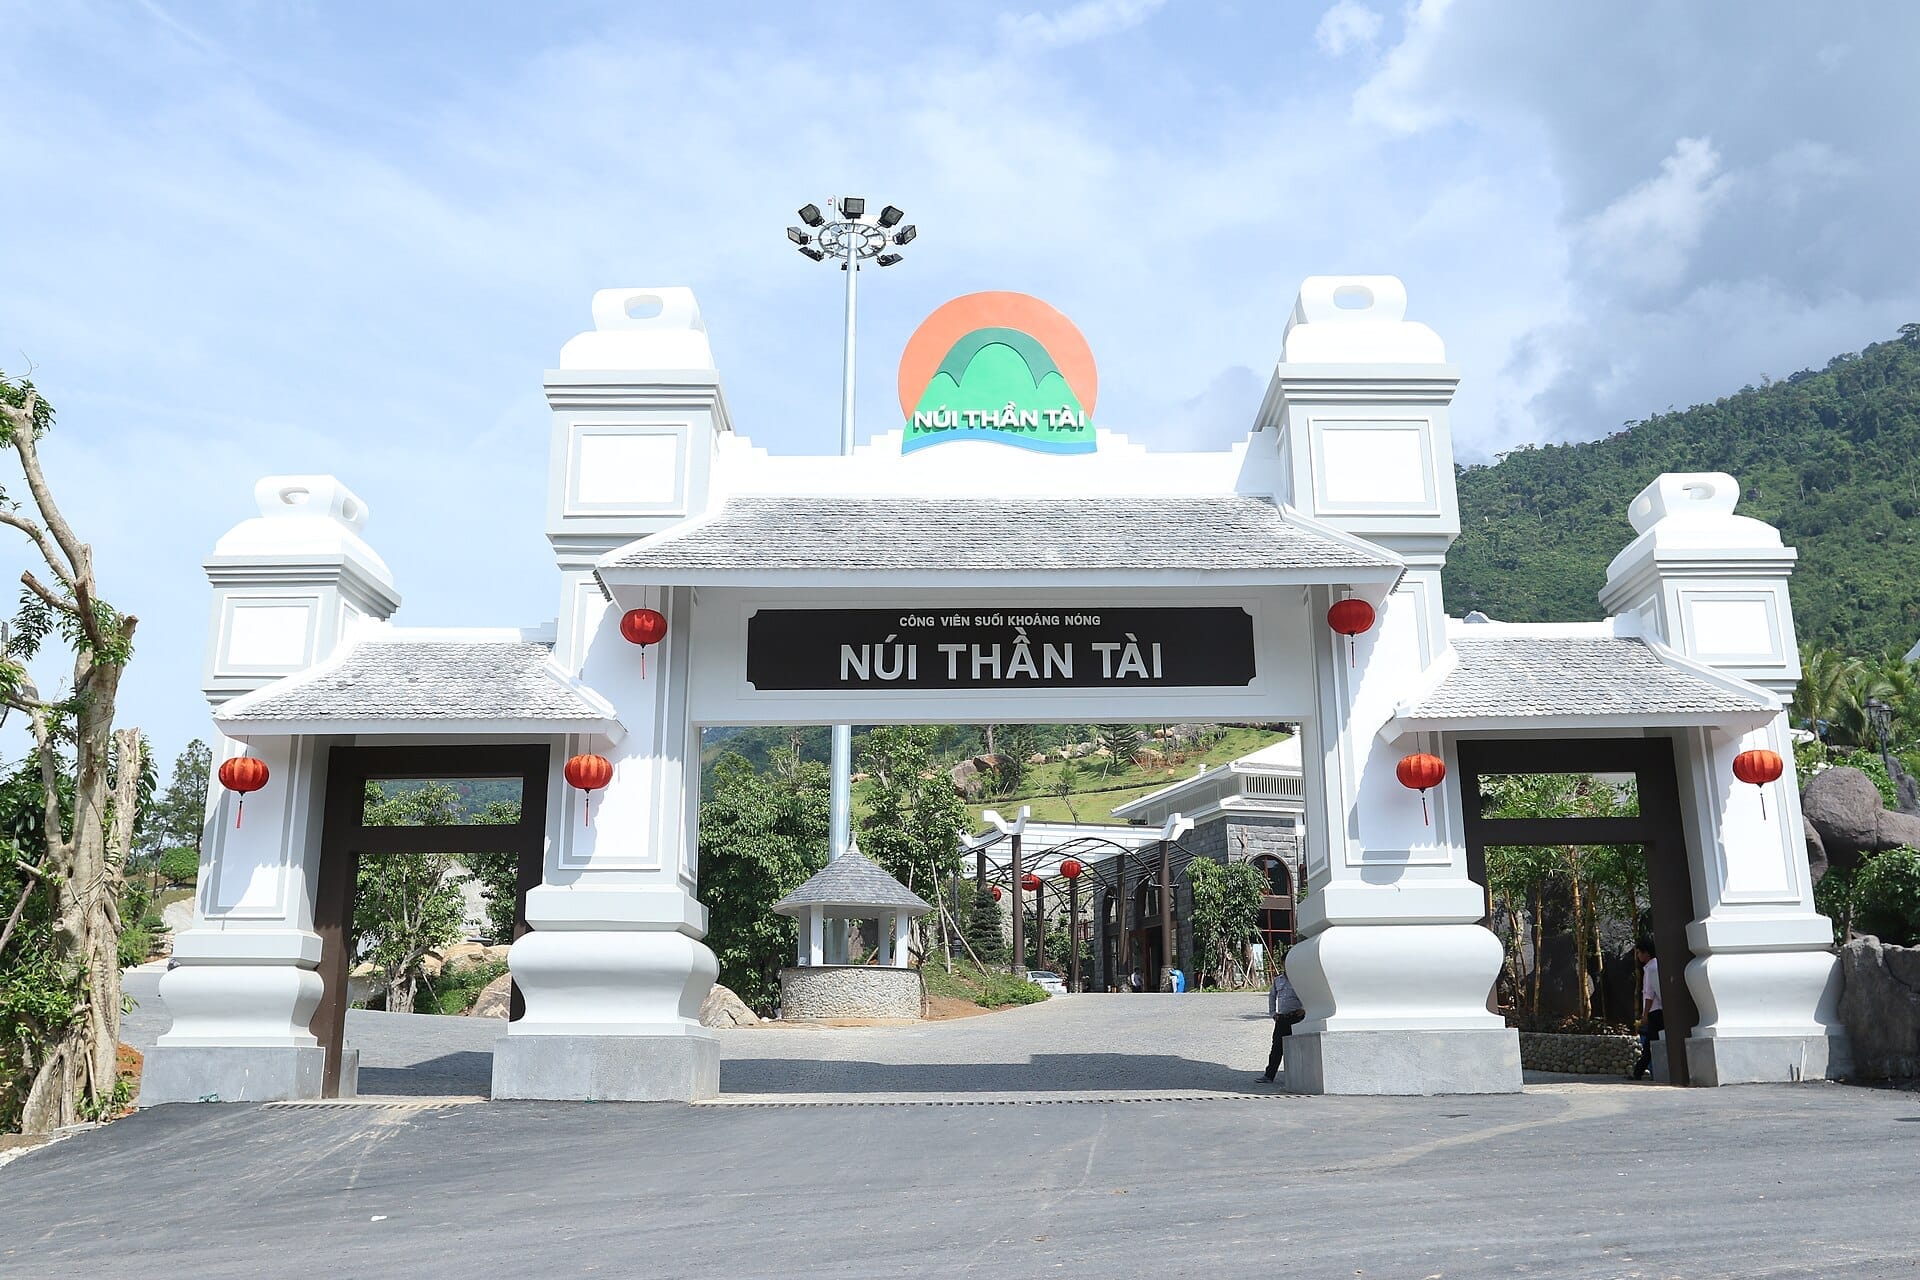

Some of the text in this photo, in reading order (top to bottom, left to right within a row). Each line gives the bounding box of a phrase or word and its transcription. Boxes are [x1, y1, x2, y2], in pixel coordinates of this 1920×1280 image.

[914, 401, 1085, 429] NÚI THẦN TÀI
[899, 610, 1101, 627] CÔNG VIÊN SUỐI KHOÁNG NÓNG
[839, 626, 1163, 681] NÚI THẦN TÀI
